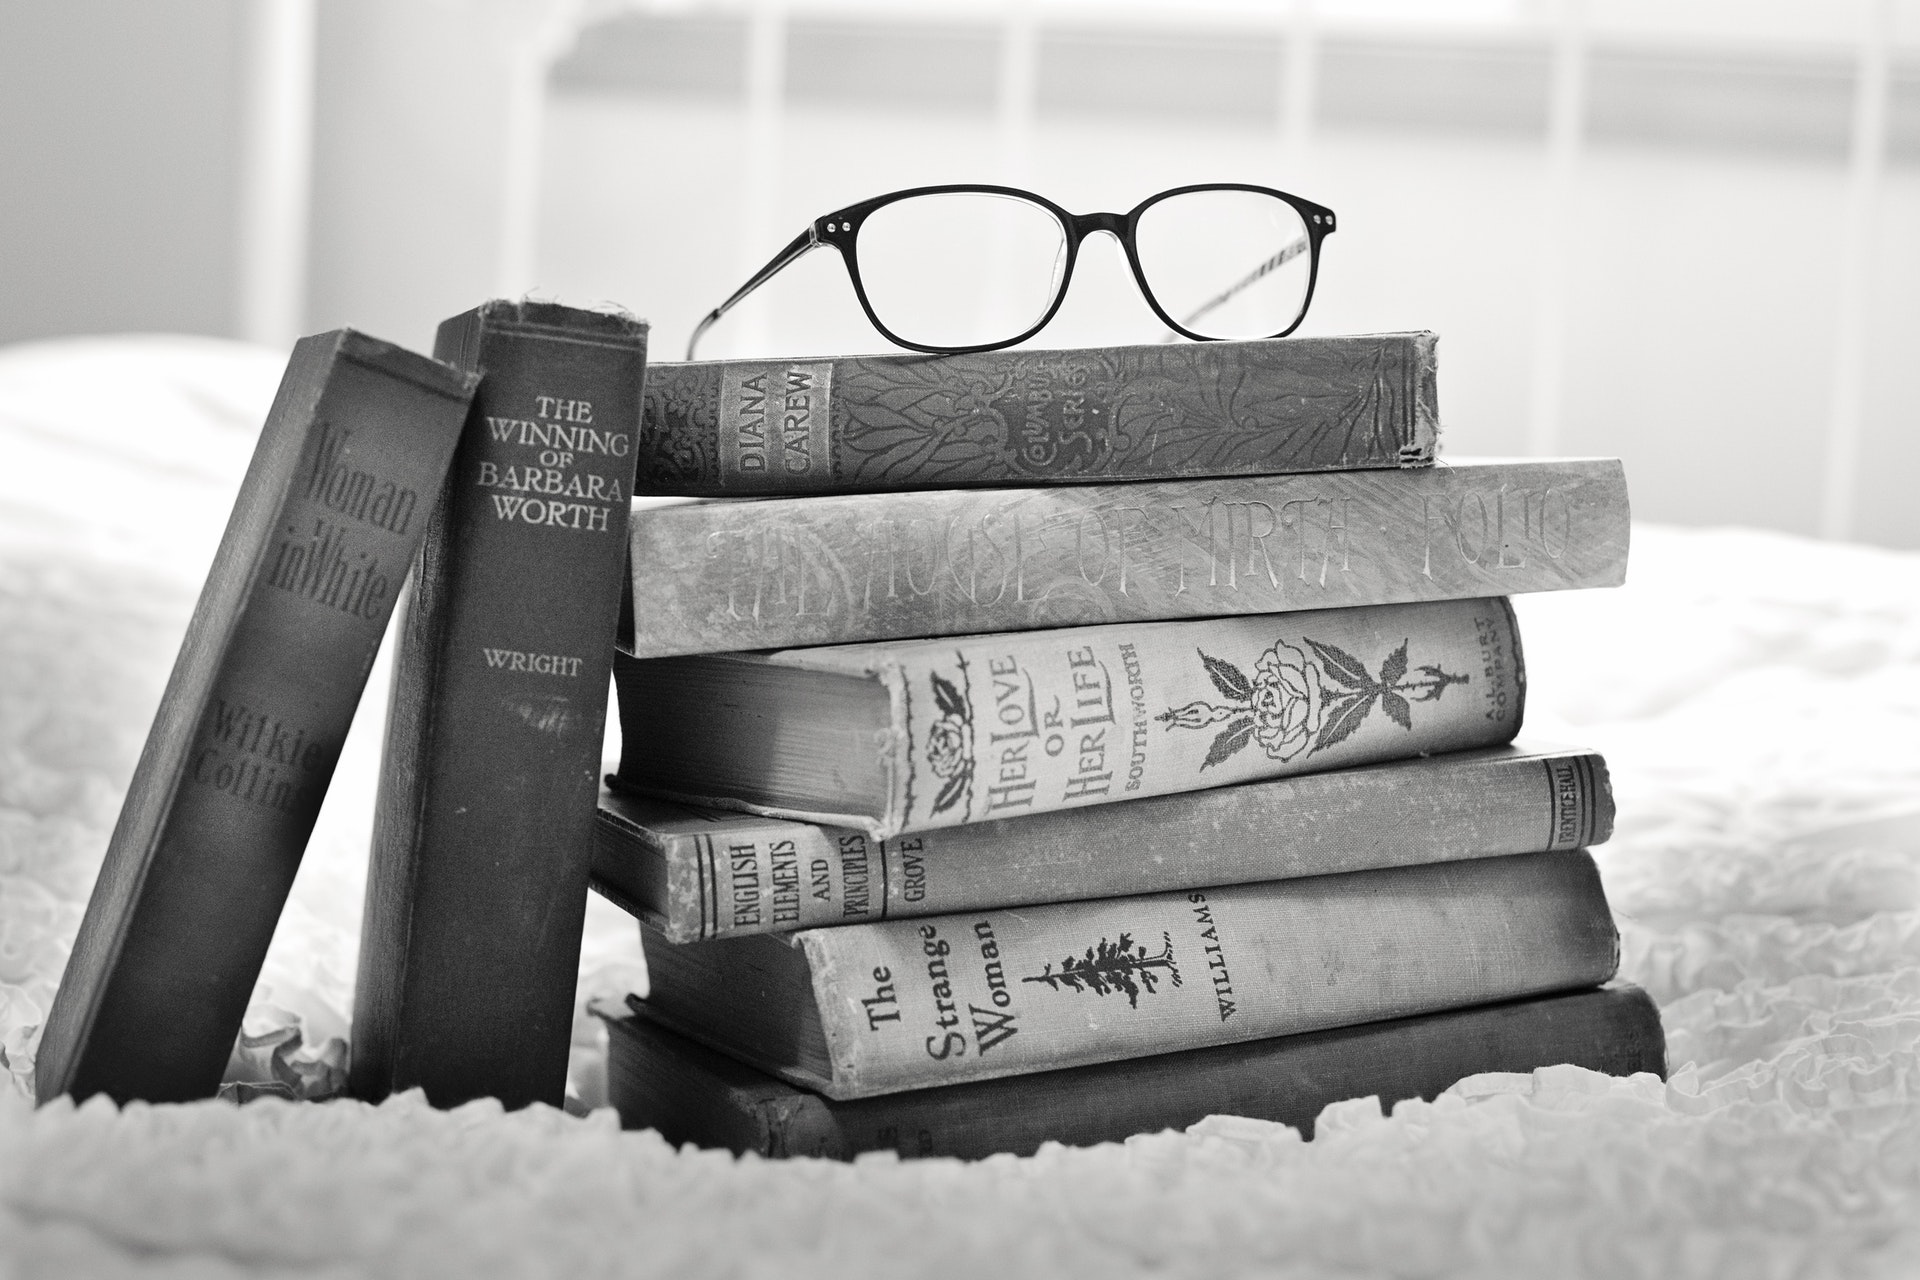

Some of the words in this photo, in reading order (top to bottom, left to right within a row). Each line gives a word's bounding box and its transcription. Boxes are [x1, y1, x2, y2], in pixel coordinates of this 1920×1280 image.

[486, 417, 630, 457] WINNING
[535, 396, 594, 423] THE
[738, 370, 768, 474] DIANA
[784, 370, 813, 477] CAREW
[304, 421, 417, 535] Woman
[477, 462, 625, 501] BARBARA
[539, 450, 574, 468] OF
[491, 495, 610, 532] WORTH
[1171, 496, 1352, 596] MIRTH
[483, 648, 583, 677] WRIGHT
[1486, 616, 1507, 722] COMPANY
[215, 699, 323, 771] Wilkie
[1044, 694, 1066, 757] OR
[1118, 642, 1148, 791] SOUTHWORTH
[730, 843, 761, 928] ENGLISH
[770, 839, 801, 924] ELEMENTS
[812, 858, 830, 902] AND
[840, 834, 869, 918] PRINCIPLES
[903, 837, 924, 903] GROVE
[867, 965, 901, 1032] The
[920, 923, 966, 1061] Strange
[968, 920, 1018, 1057] Woman
[1188, 891, 1237, 1023] WILLIAMS
